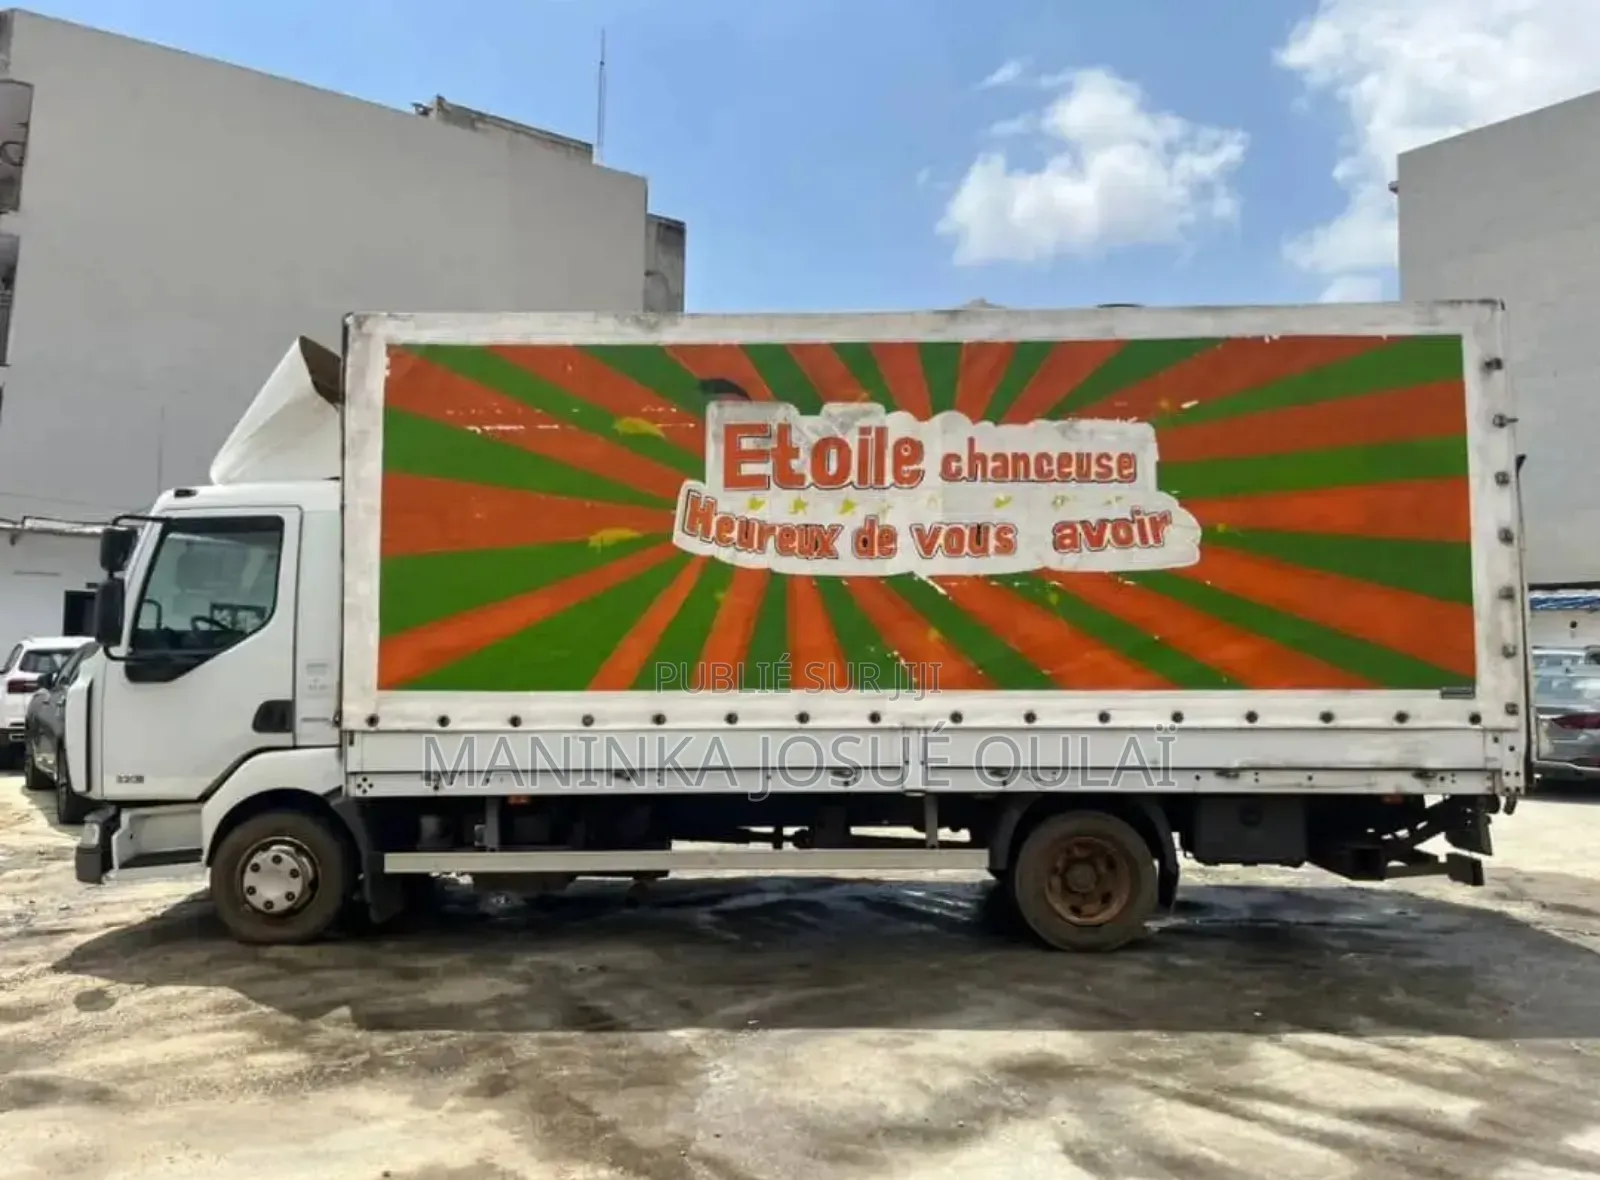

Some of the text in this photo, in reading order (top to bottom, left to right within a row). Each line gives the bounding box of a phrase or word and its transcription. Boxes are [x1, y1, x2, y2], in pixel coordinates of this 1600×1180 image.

[722, 422, 1138, 491] Etoile chanceuse
[685, 492, 1172, 559] Heureux de vous avoir
